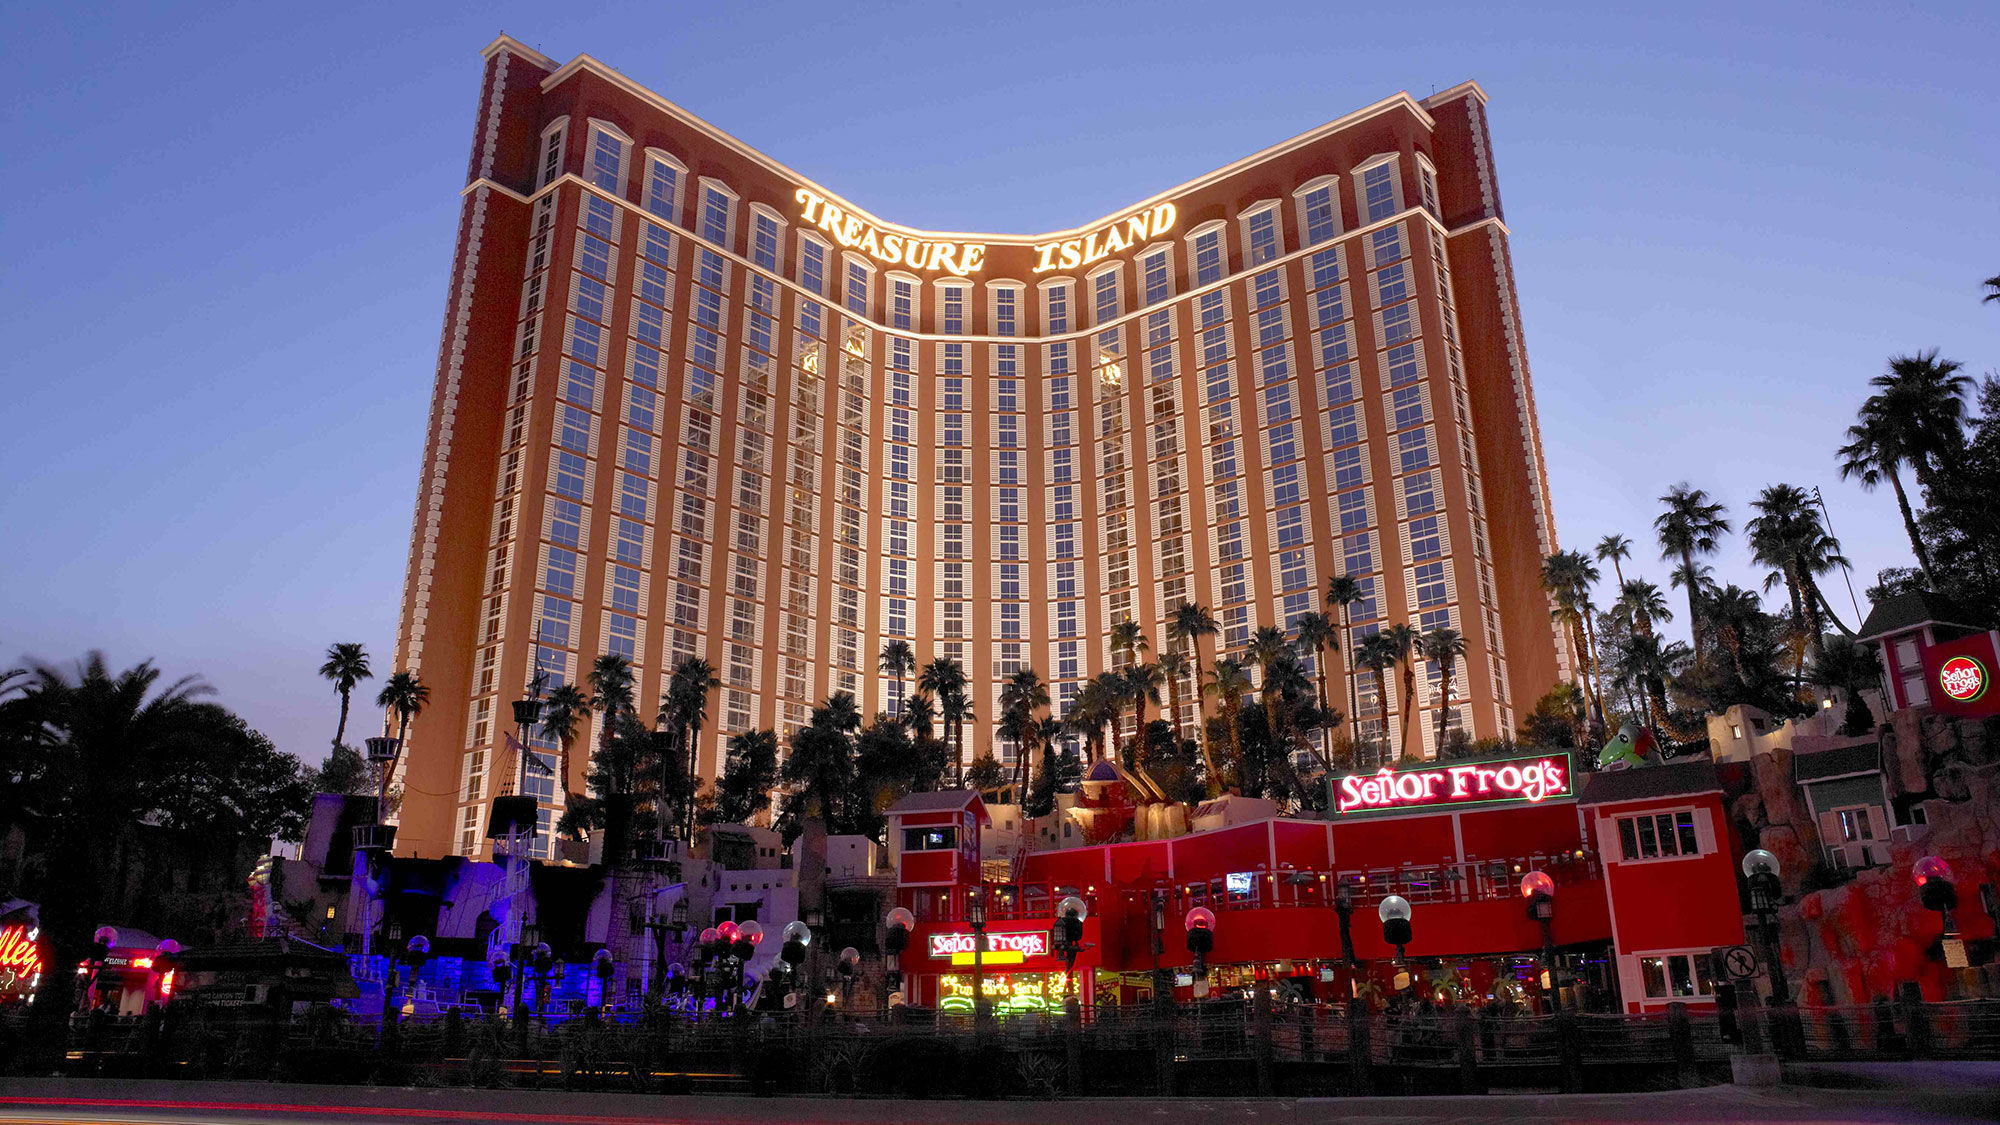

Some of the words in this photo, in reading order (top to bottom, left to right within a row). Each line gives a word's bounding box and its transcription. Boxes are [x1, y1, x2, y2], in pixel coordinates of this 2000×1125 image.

[796, 189, 985, 275] TREASURE
[1032, 202, 1176, 273] ISLAND
[1943, 668, 1978, 683] Señor
[1340, 767, 1443, 813] Señor
[932, 933, 977, 956] Seño
